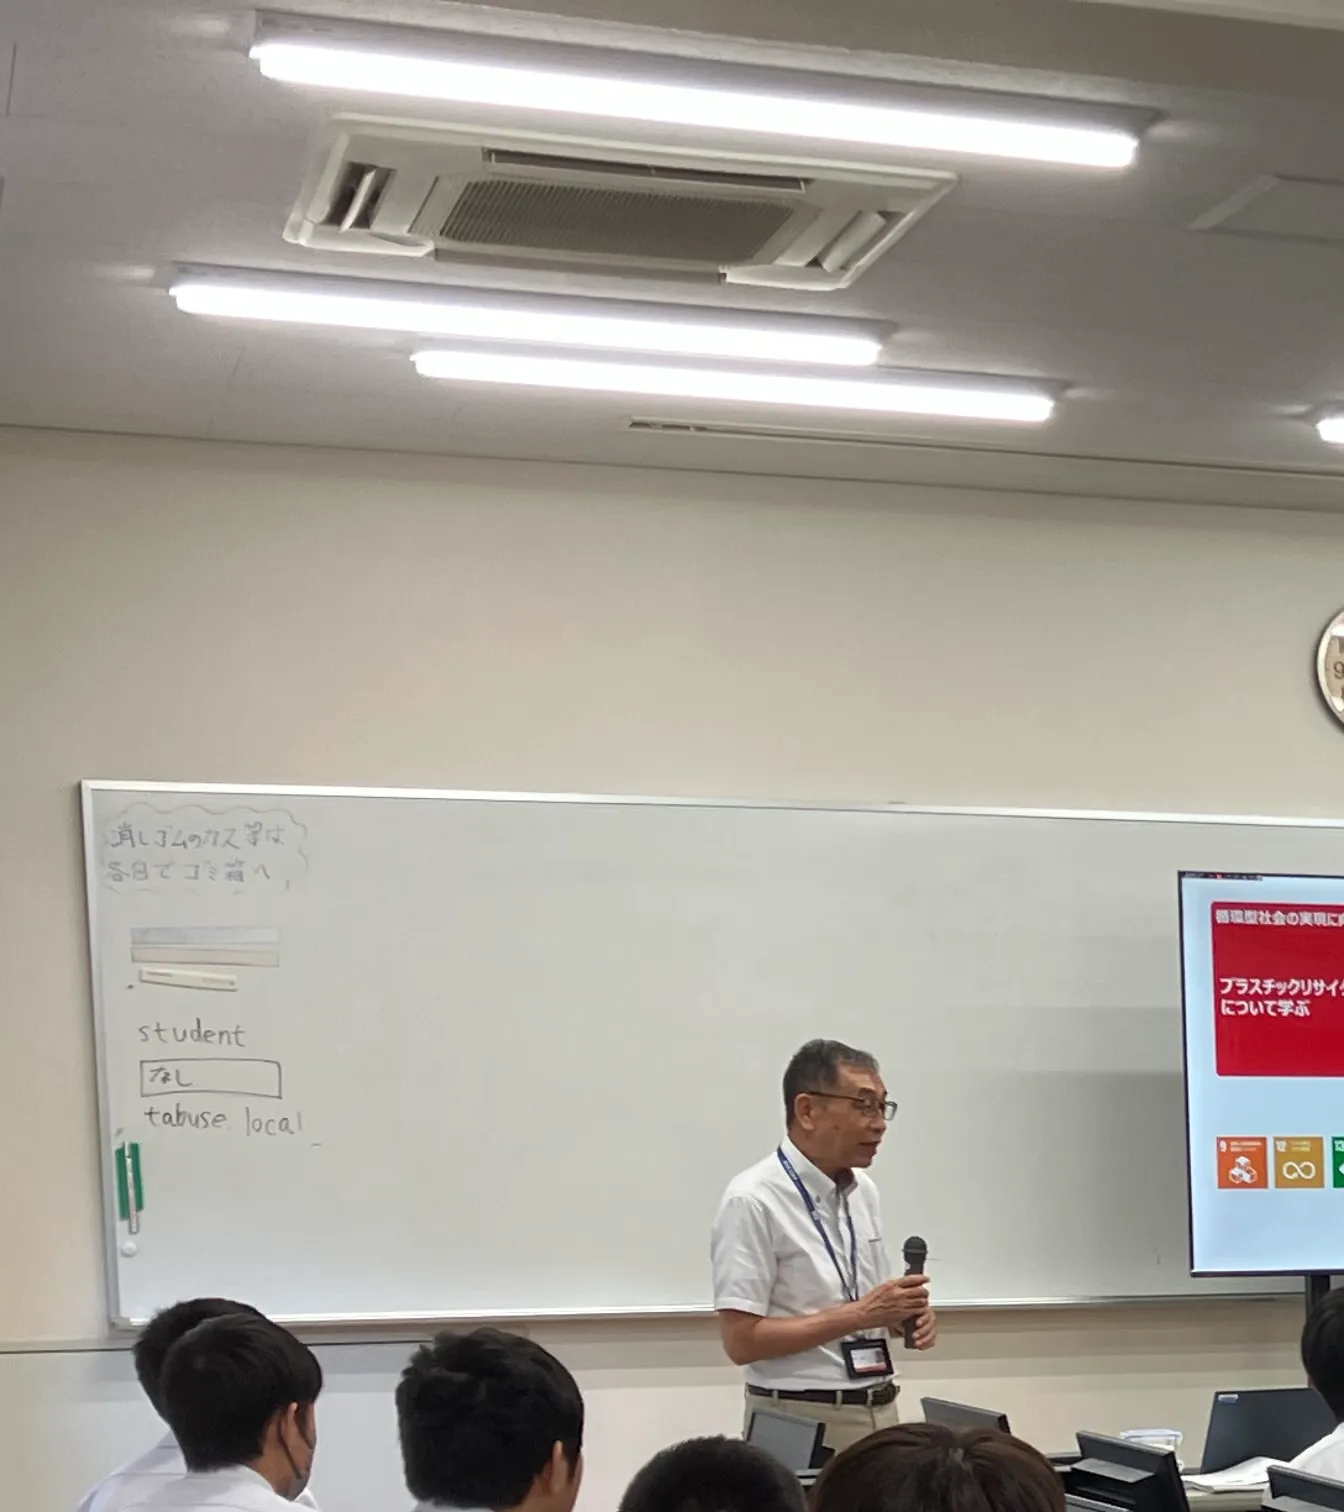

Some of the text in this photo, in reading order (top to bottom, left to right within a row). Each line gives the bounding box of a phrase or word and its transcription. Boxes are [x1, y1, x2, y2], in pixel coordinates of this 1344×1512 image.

[1220, 998, 1311, 1017] について学ぶ
[138, 1018, 247, 1049] student
[148, 1067, 193, 1089] なし
[1219, 1140, 1227, 1152] 9
